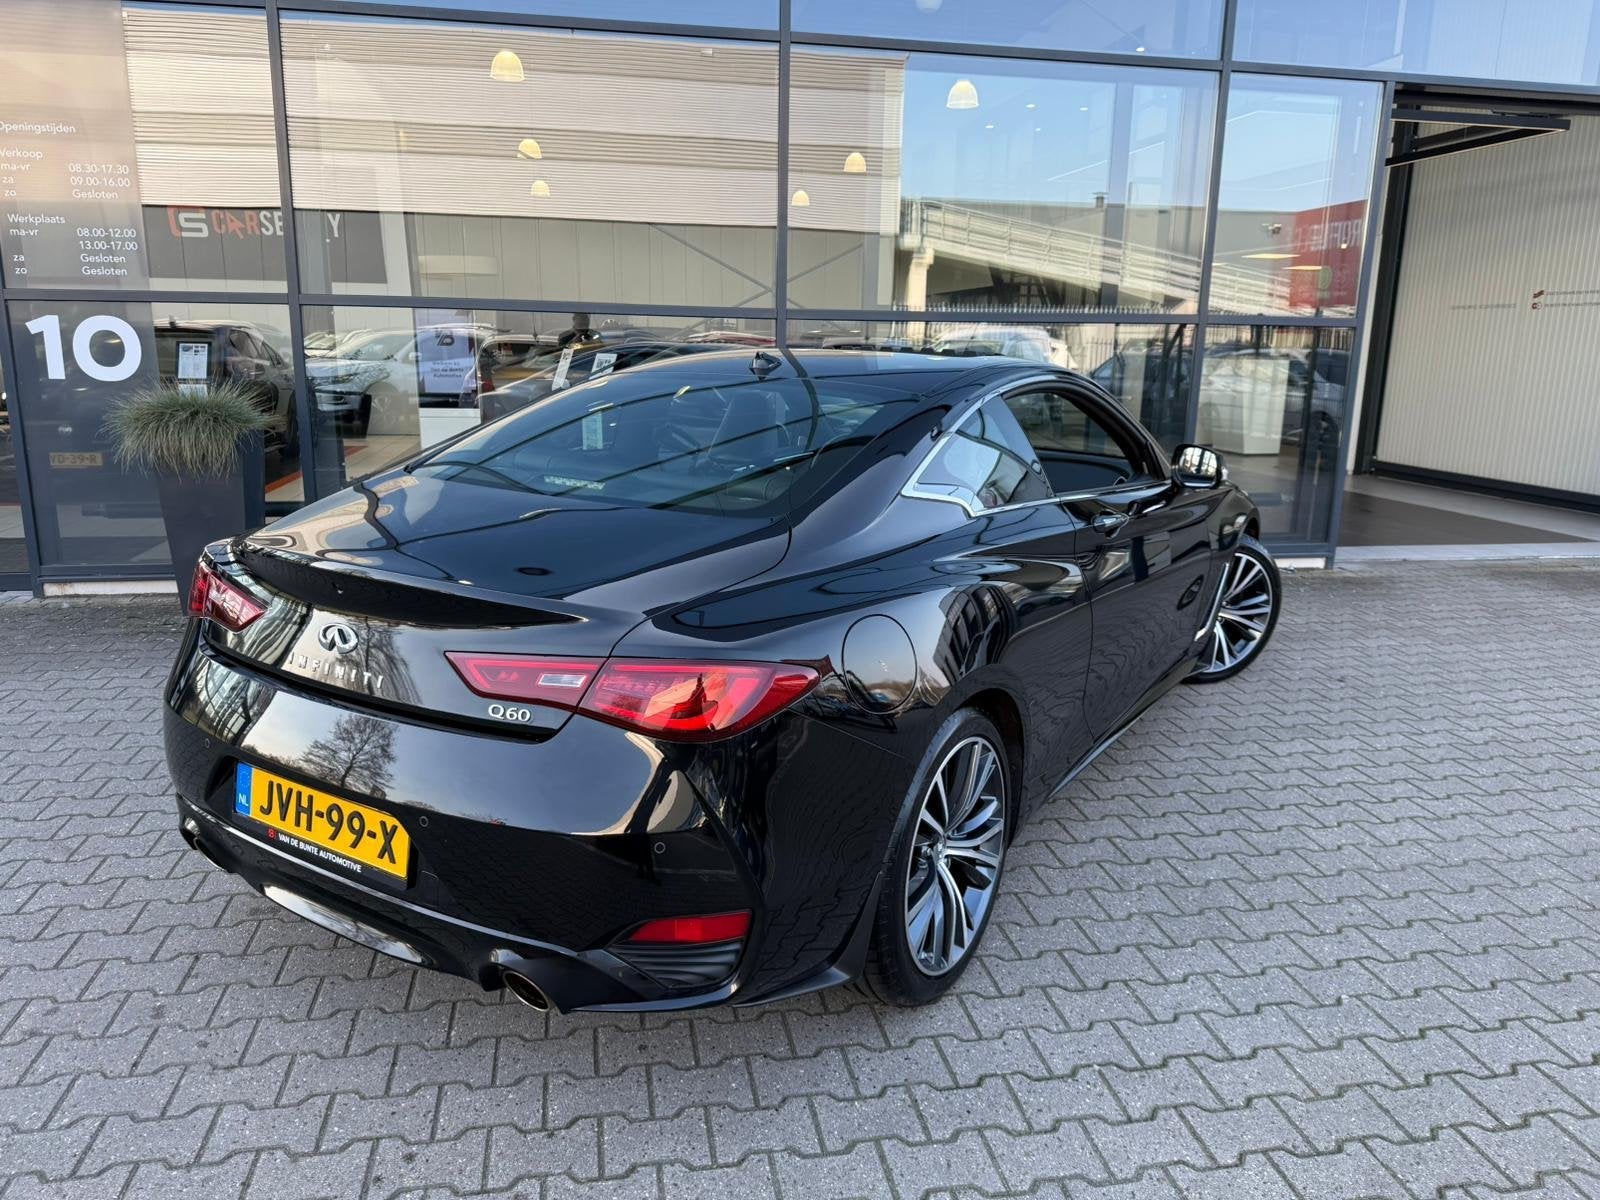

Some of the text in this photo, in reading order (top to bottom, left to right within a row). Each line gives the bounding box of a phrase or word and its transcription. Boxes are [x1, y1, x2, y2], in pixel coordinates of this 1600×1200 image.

[0, 162, 129, 174] ma-vr 08.30-17.30
[2, 176, 130, 187] za 09.00-16.00
[4, 188, 119, 200] zo Gesloten
[7, 213, 66, 225] Werkplaats
[9, 227, 137, 238] ma-vr 08.00-12.00
[79, 240, 138, 251] 13.00-17.00
[80, 253, 126, 264] Gesloten
[82, 266, 128, 276] Gesloten
[25, 314, 142, 382] 10
[288, 651, 384, 690] INFINITI
[487, 703, 531, 723] Q60
[238, 793, 249, 807] NL
[259, 780, 398, 864] JVH-99-X
[278, 832, 290, 844] VAN
[290, 838, 299, 848] DE
[299, 841, 319, 856] BUNTE
[319, 849, 362, 873] AUTOMOTIVE
